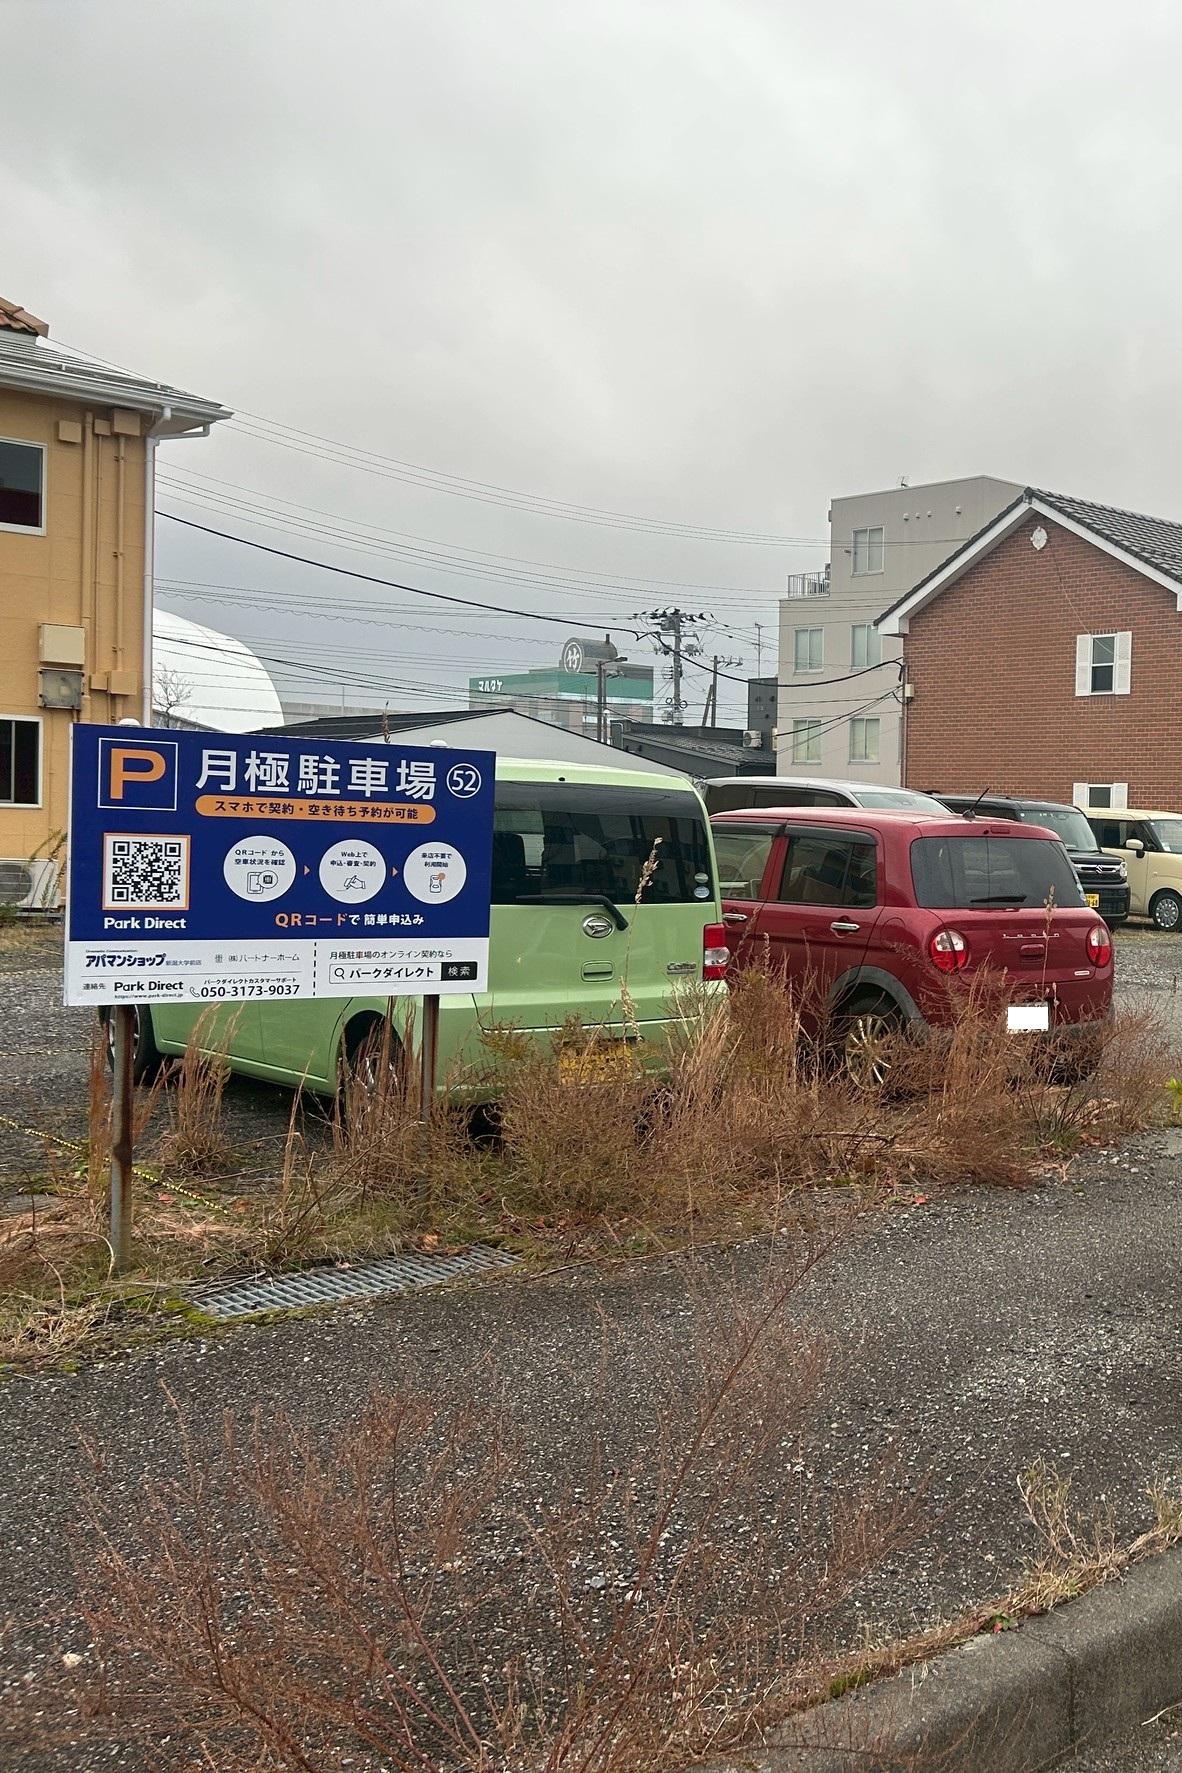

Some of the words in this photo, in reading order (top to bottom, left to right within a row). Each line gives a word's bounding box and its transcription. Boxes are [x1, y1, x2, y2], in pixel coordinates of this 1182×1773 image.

[566, 647, 580, 670] 竹
[110, 748, 166, 800] P
[195, 749, 437, 800] 月極駐車場
[215, 800, 418, 820] スマホで契約・空き待ち予約が可能
[235, 849, 268, 857] QRコード
[103, 916, 141, 929] Park
[144, 916, 187, 929] Direct
[275, 912, 361, 928] QRコードで
[364, 913, 425, 926] 簡単申込み
[85, 953, 167, 968] アパマンショップ
[329, 950, 453, 960] 月極駐車場のオンライン契約なら
[349, 967, 434, 979] パークダイレクト
[447, 966, 472, 977] 検索
[114, 981, 145, 992] Park
[148, 980, 184, 991] Direct
[200, 984, 300, 998] 050-3173-9037
